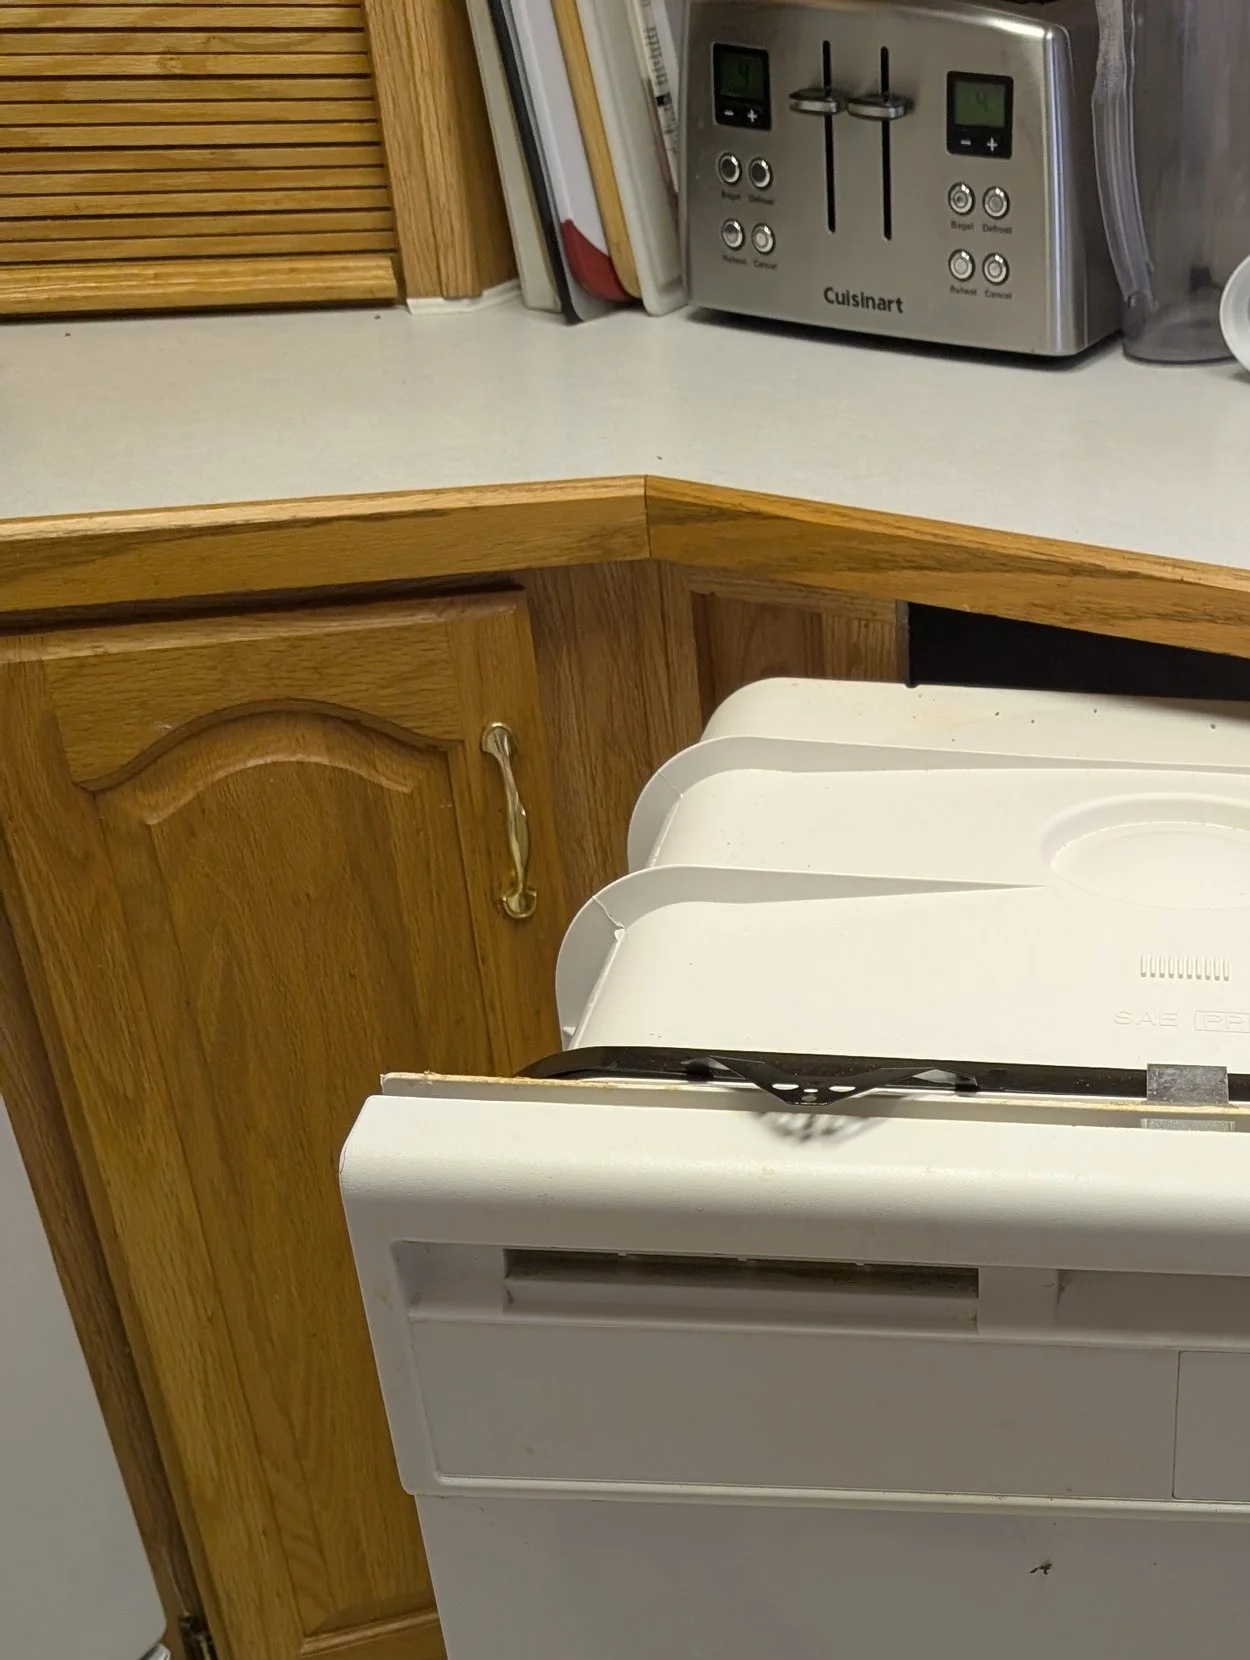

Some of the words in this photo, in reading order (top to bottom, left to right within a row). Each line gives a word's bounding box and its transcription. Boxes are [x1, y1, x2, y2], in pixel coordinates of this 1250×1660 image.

[823, 286, 904, 314] Cuisinart
[1113, 1010, 1179, 1027] SAE
[1201, 1013, 1245, 1030] PP
